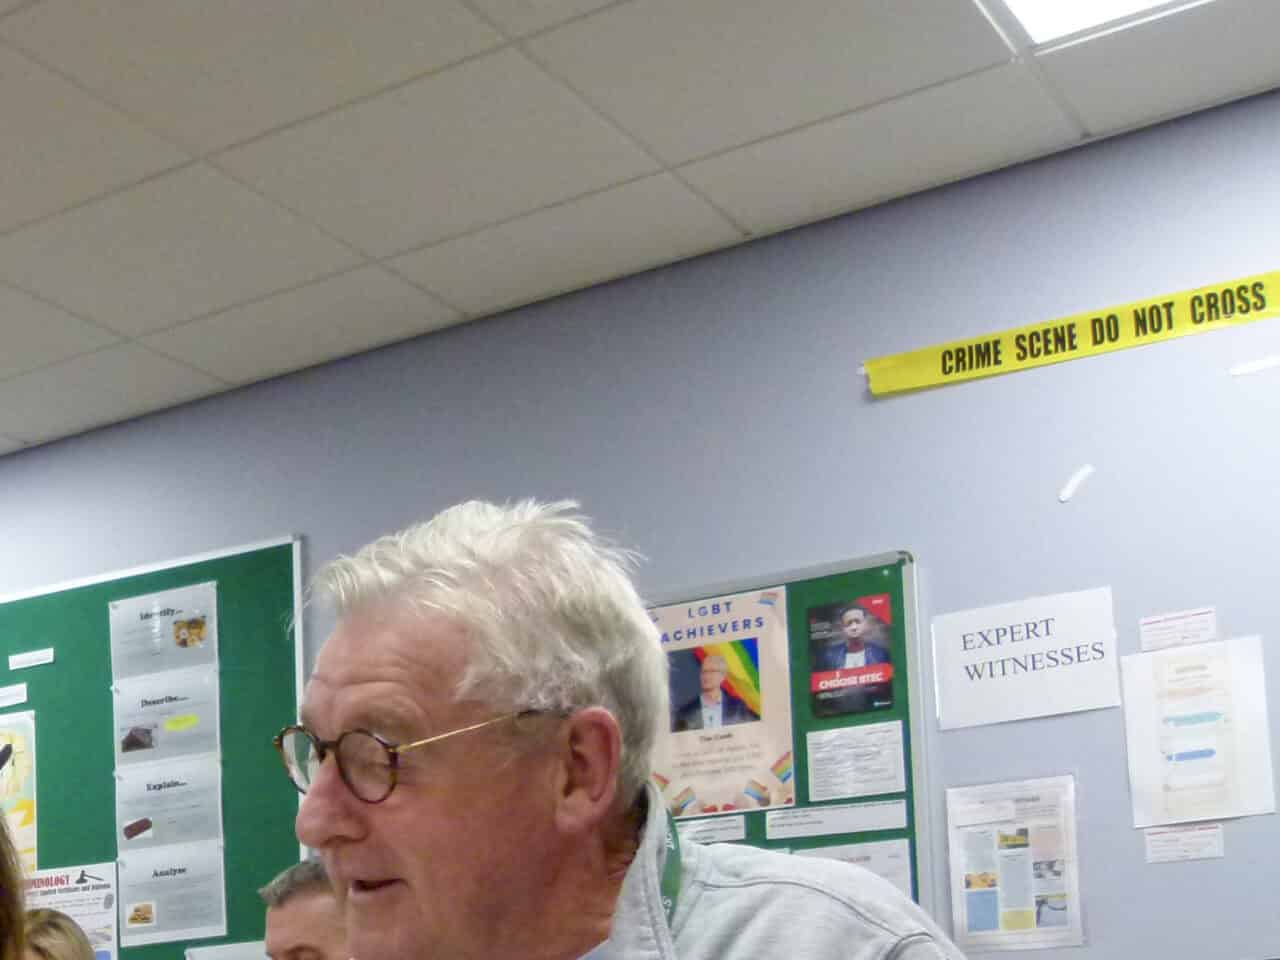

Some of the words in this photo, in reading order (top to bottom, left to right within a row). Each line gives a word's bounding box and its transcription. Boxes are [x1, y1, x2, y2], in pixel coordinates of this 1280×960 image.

[941, 339, 1002, 376] CRIME
[1014, 323, 1078, 362] SCENE
[1091, 313, 1121, 346] DO
[1133, 301, 1176, 337] NOT
[1190, 281, 1267, 325] CROSS
[687, 600, 733, 619] LGBT
[660, 616, 765, 645] ACHIEVERS
[961, 617, 1057, 651] EXPERT
[964, 641, 1105, 681] WITNESSES
